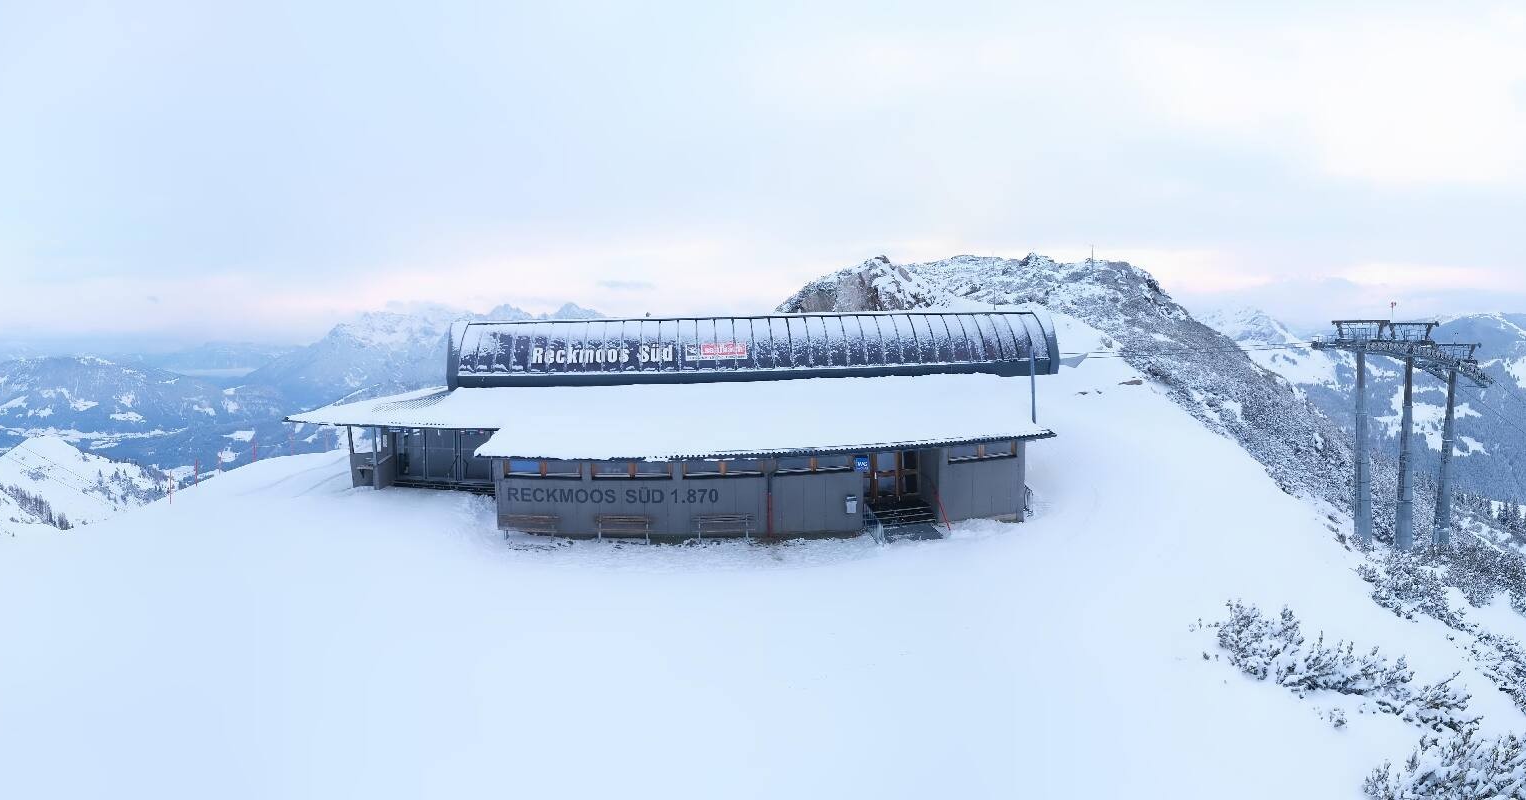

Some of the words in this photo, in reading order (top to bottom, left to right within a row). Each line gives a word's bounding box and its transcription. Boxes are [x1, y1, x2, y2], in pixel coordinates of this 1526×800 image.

[531, 346, 630, 364] Reckmoos
[639, 343, 673, 363] Süd
[507, 487, 617, 504] RECKMOOS
[625, 487, 665, 504] SÜD
[670, 488, 719, 504] 1.870
